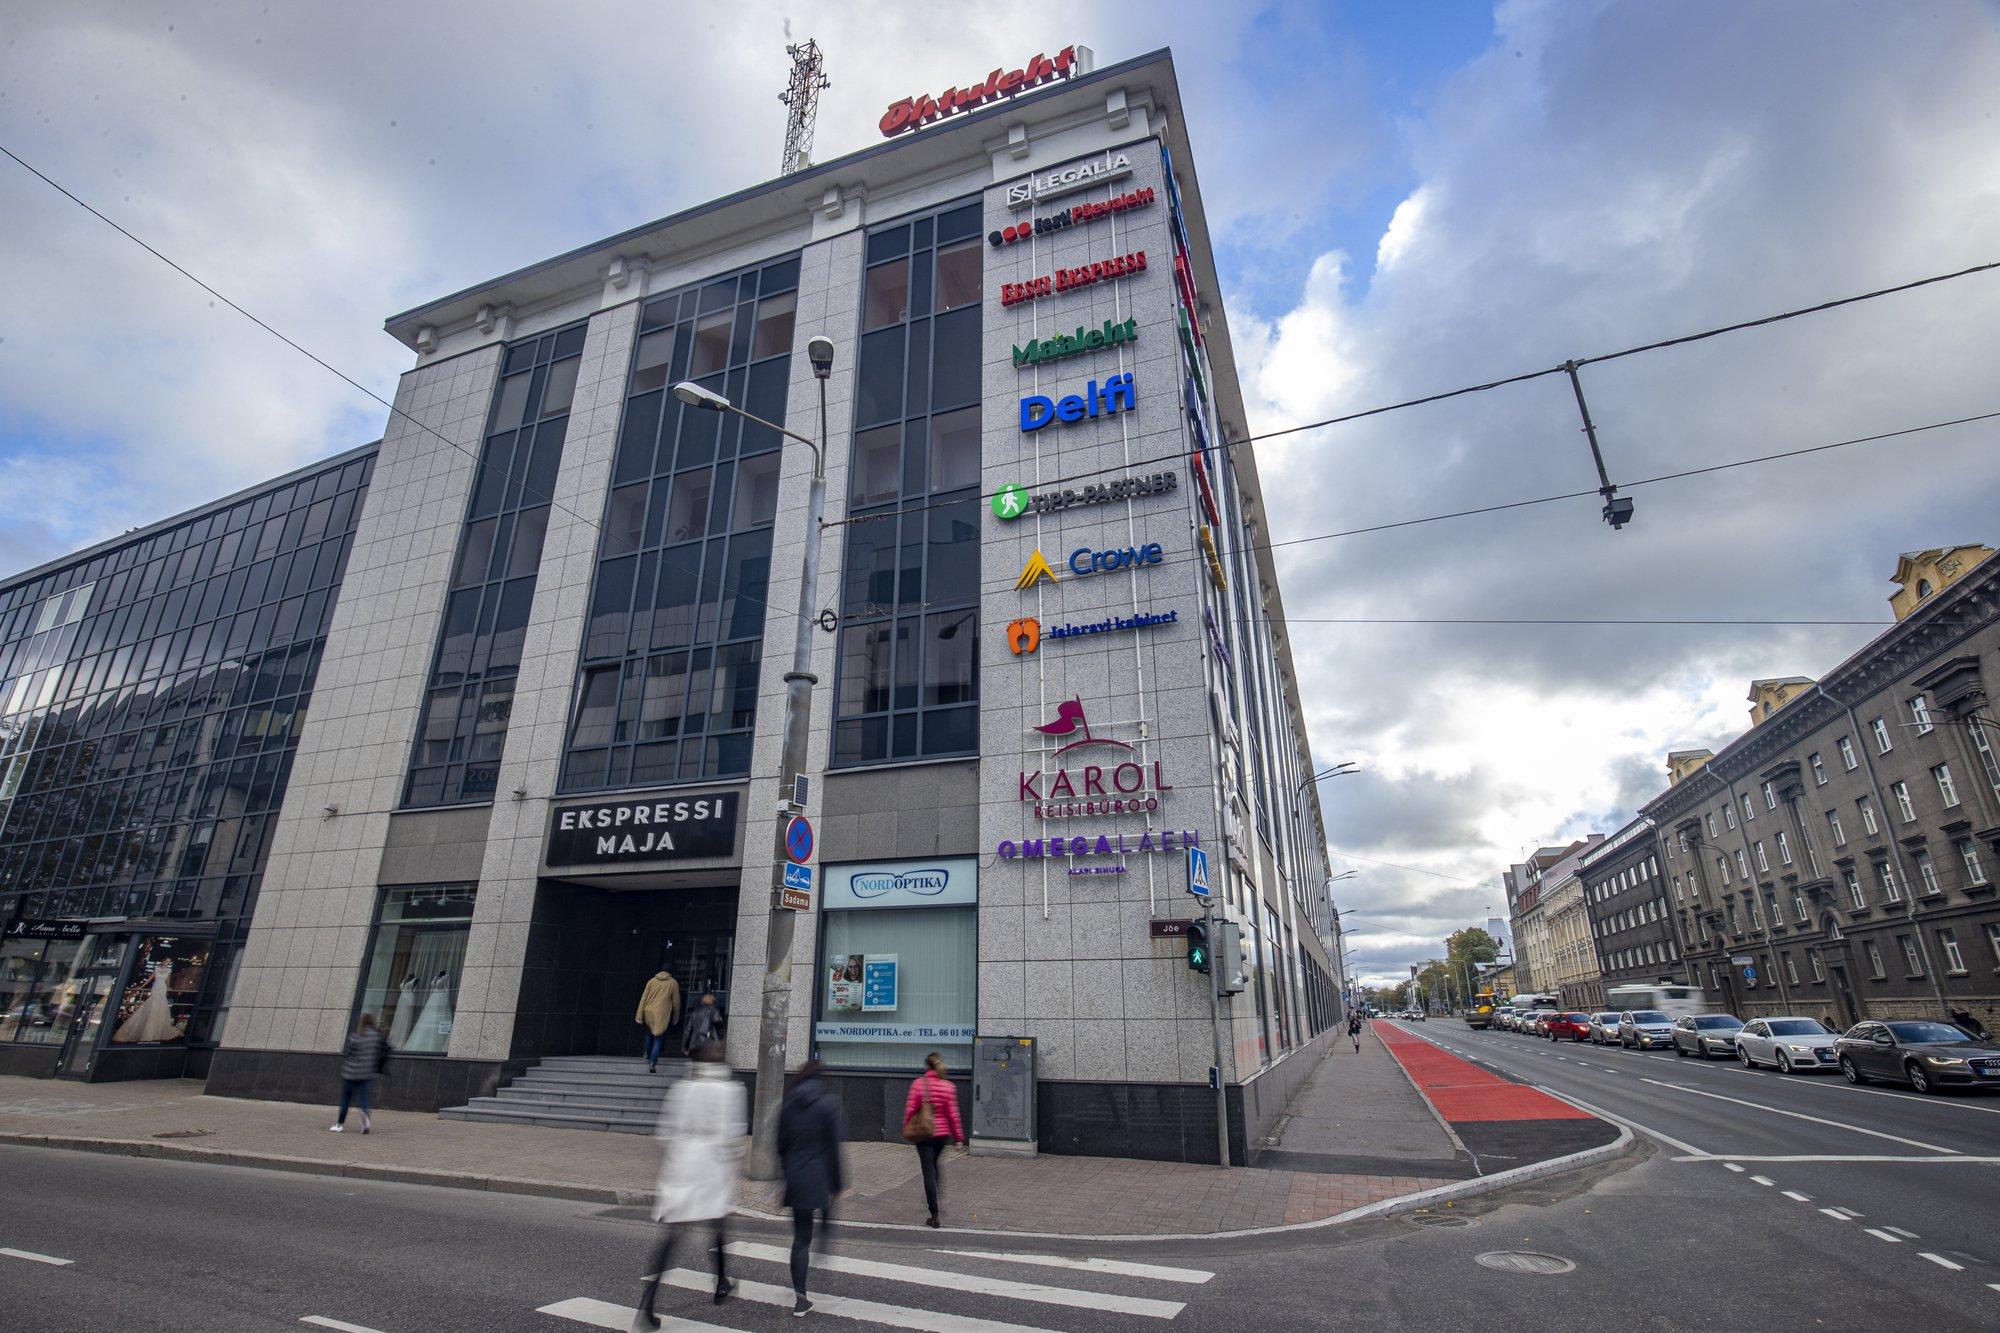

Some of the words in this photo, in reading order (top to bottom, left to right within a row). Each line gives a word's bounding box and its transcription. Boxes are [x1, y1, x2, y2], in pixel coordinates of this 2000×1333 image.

[879, 45, 1076, 138] Õhtuleht
[1035, 153, 1131, 192] LEGALIA
[1001, 275, 1052, 307] EESTI
[1054, 250, 1148, 293] EKSPRESS
[1012, 315, 1138, 368] Maaleht
[1020, 372, 1136, 433] Delfi
[1032, 471, 1177, 513] TIPP-PARTNER
[1068, 542, 1163, 575] Crowe
[1050, 618, 1113, 639] Jalaravi
[1114, 609, 1178, 631] kabinet
[1020, 760, 1173, 801] KAROL
[560, 799, 723, 831] EKSPRESSI
[1034, 797, 1158, 819] REISIBÜROO
[596, 831, 674, 855] MAJA
[998, 829, 1200, 859] OMEGALAEN
[859, 876, 942, 891] NORDOPTIKA
[784, 893, 809, 907] Sadama
[918, 1029, 937, 1037] TEL.
[939, 1029, 949, 1037] 66
[950, 1029, 959, 1037] 01
[961, 1028, 975, 1037] 902
